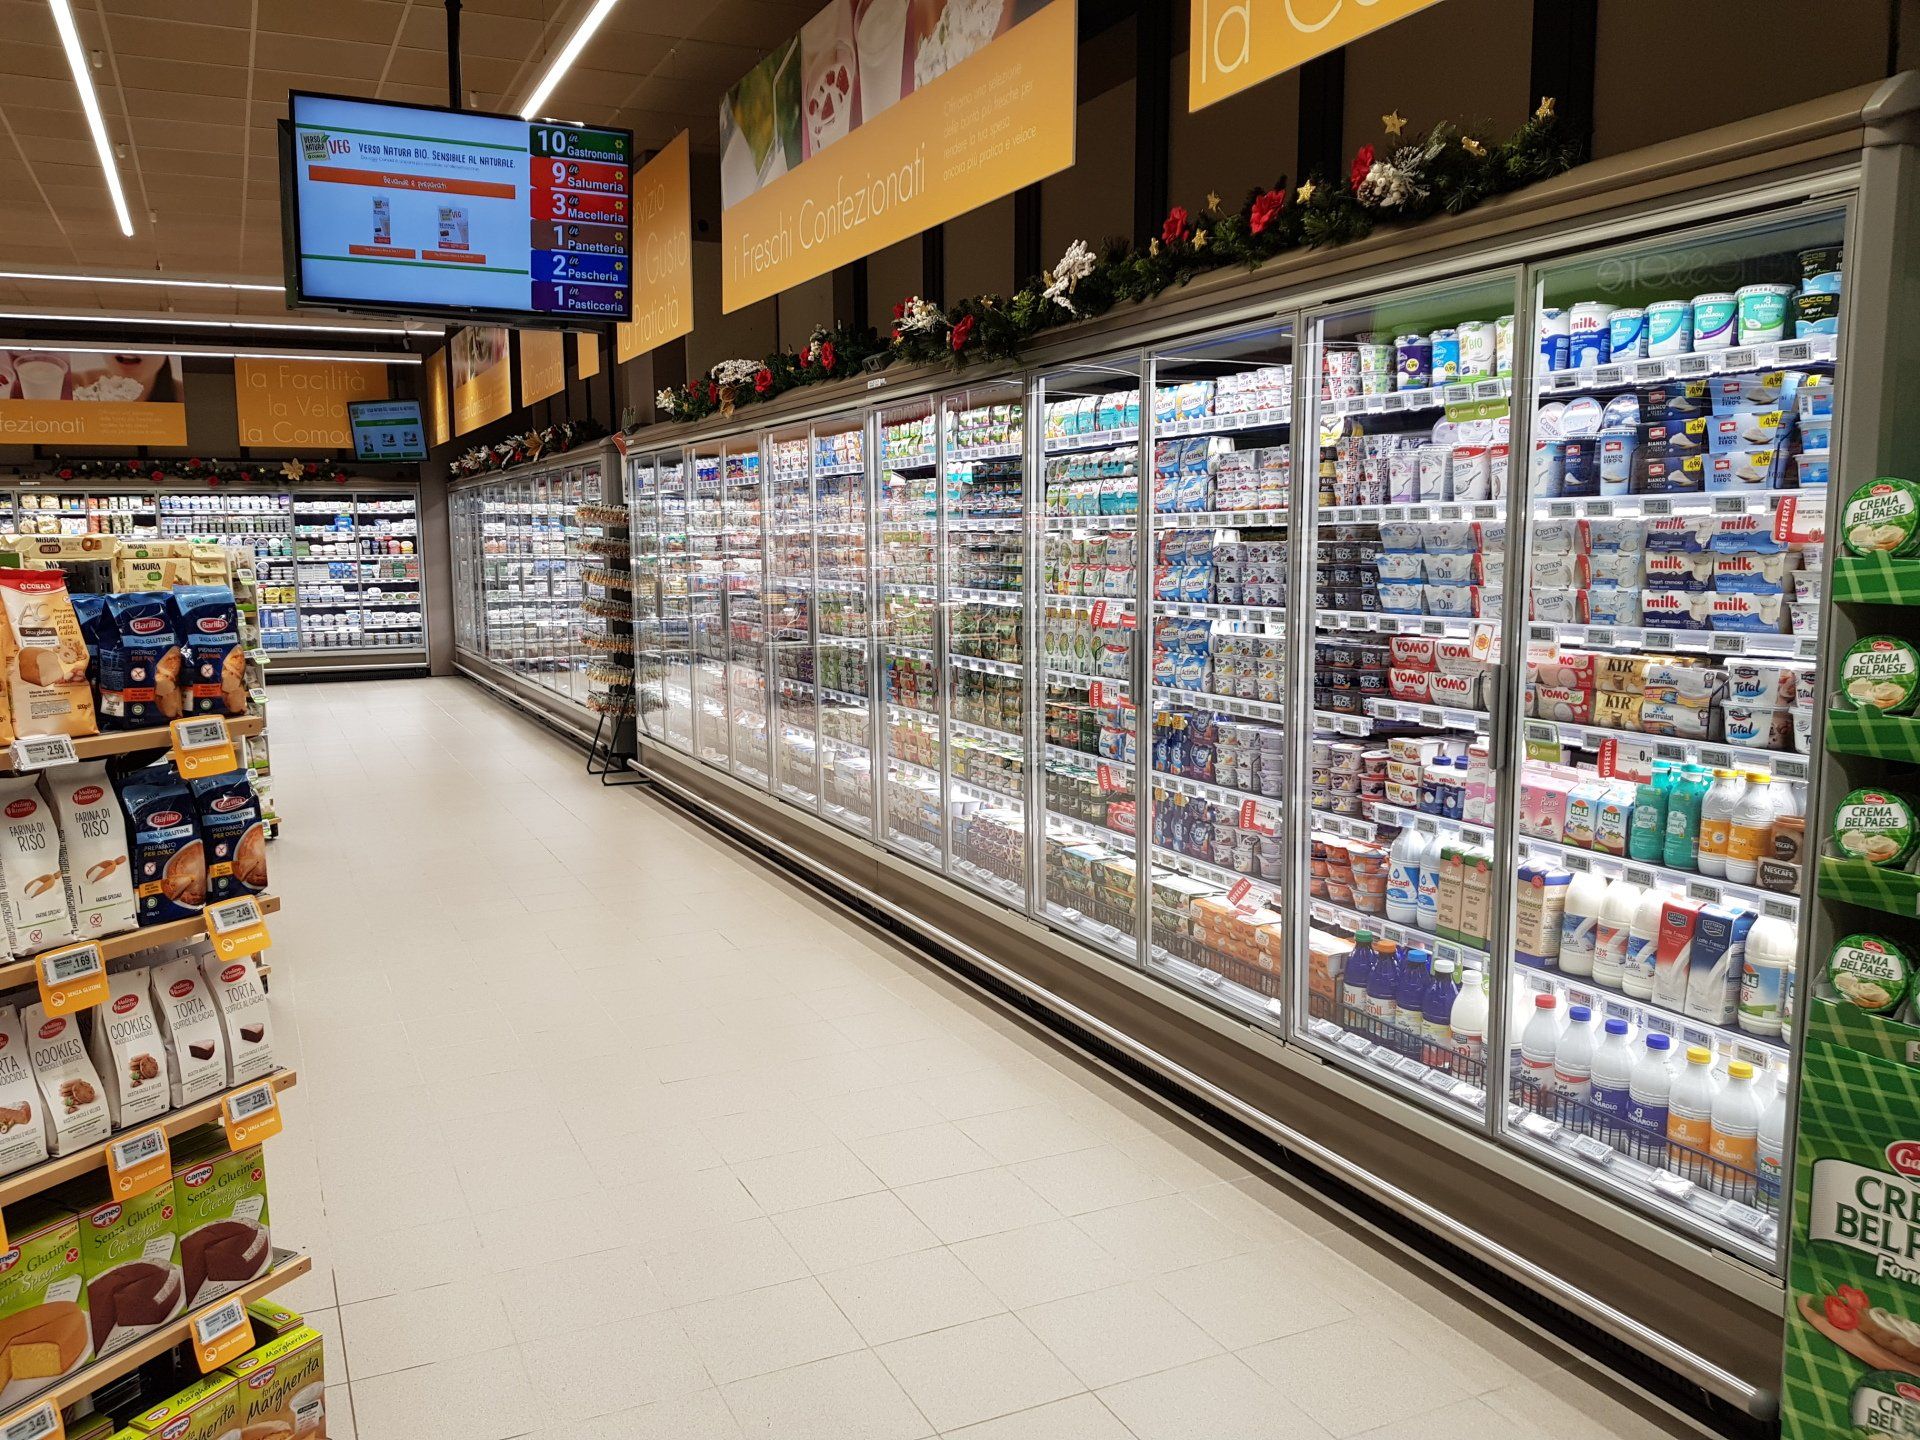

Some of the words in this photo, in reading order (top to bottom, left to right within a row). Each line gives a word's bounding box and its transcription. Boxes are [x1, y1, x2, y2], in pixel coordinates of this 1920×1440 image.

[537, 130, 566, 153] 10
[569, 132, 579, 143] in
[329, 140, 351, 154] VEG
[358, 142, 381, 154] VERSO
[383, 145, 412, 157] NATURA
[432, 150, 465, 163] SENSIBILE
[468, 155, 477, 165] AL
[567, 145, 624, 161] Gastronomia
[552, 162, 566, 183] 9
[569, 163, 579, 174] in
[567, 175, 624, 192] Salumeria
[552, 194, 566, 215] 3
[569, 195, 579, 205] in
[567, 208, 624, 223] Macelleria
[743, 217, 793, 280] Freschi
[799, 141, 926, 249] Confezionati
[553, 225, 563, 245] 1
[569, 225, 579, 236] in
[567, 241, 624, 254] Panetteria
[646, 224, 688, 284] Gusto
[552, 255, 566, 276] 2
[569, 255, 579, 265] in
[567, 268, 619, 282] Pescheria
[553, 286, 564, 306] 1
[569, 286, 579, 296] in
[567, 298, 624, 312] Pasticceria
[1571, 316, 1597, 330] milk
[1469, 337, 1483, 350] BIO
[244, 363, 267, 388] la
[279, 364, 365, 391] Facilità
[268, 392, 287, 417] la
[296, 396, 346, 418] Velo
[242, 418, 263, 443] la
[1859, 494, 1899, 512] CREMA
[1655, 516, 1686, 529] milk
[1720, 516, 1755, 529] milk
[1778, 498, 1791, 540] OFFERTA
[132, 562, 161, 571] MiSURA
[1650, 556, 1682, 569] milk
[1718, 557, 1752, 570] milk
[1646, 595, 1679, 608] milk
[1713, 597, 1748, 611] milk
[134, 620, 162, 631] Barilla
[201, 620, 226, 630] Barilla
[1396, 641, 1429, 654] YOMO
[1441, 645, 1470, 658] YOM
[1859, 653, 1900, 666] CREMA
[1394, 671, 1425, 683] YOMO
[1435, 677, 1467, 691] YOMO
[1649, 676, 1679, 686] parmalat
[1540, 687, 1570, 701] YOMO
[1734, 681, 1761, 694] Total
[1605, 694, 1631, 710] KYR
[1644, 711, 1674, 721] parmalat
[1728, 722, 1754, 735] Total
[1603, 739, 1613, 777] OFFERTA
[75, 810, 101, 823] FARINA
[101, 808, 111, 818] DI
[1571, 805, 1588, 816] SOLE
[1602, 811, 1619, 822] SOLE
[1851, 806, 1892, 818] CREMA
[153, 814, 179, 824] Barilla
[9, 824, 35, 838] FARINA
[36, 823, 46, 833] DI
[82, 820, 109, 839] RISO
[164, 828, 191, 838] GLUTINE
[17, 834, 46, 852] RISO
[1388, 877, 1410, 888] Accadi
[1709, 940, 1726, 949] Fresco
[1848, 949, 1889, 968] CREMA
[67, 989, 83, 998] SENZA
[225, 982, 257, 1004] TORTA
[173, 997, 207, 1020] TORTA
[110, 1014, 152, 1040] COOKIES
[34, 1038, 82, 1068] COOKIES
[0, 1070, 28, 1086] OCCIOLE
[186, 1166, 212, 1182] cameo
[186, 1184, 216, 1206] Senza
[218, 1160, 255, 1188] Glutine
[93, 1205, 121, 1222] cameo
[94, 1223, 126, 1249] Senza
[127, 1198, 166, 1227] Glutine
[0, 1270, 24, 1290] enza
[26, 1240, 70, 1272] Glutine
[265, 1332, 309, 1358] Margherita
[250, 1368, 275, 1385] cameo
[177, 1378, 223, 1407] Margherita
[247, 1357, 320, 1424] Margherita
[262, 1380, 280, 1398] torta
[162, 1419, 189, 1438] cameo
